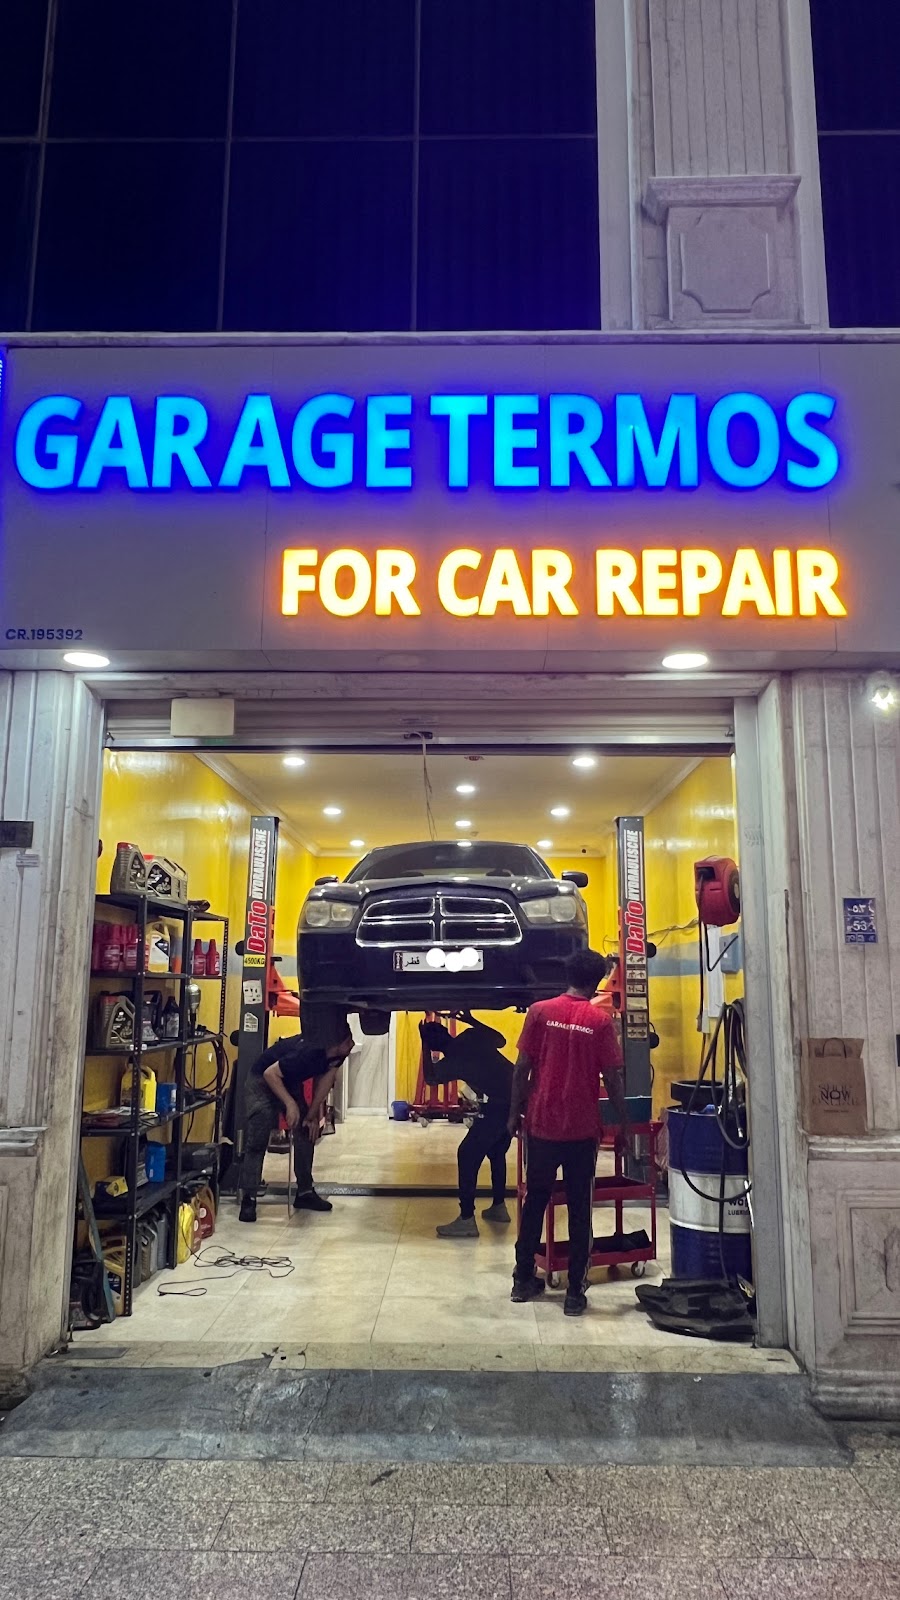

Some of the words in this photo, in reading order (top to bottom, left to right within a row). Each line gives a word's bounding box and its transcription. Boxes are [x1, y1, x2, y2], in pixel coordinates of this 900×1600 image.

[14, 394, 413, 489] GARAGE
[430, 392, 840, 489] TERMOS
[280, 547, 421, 617] FOR
[437, 547, 580, 618] CAR
[596, 547, 848, 618] REPAIR
[5, 628, 83, 641] CR.195392
[853, 920, 868, 931] 53
